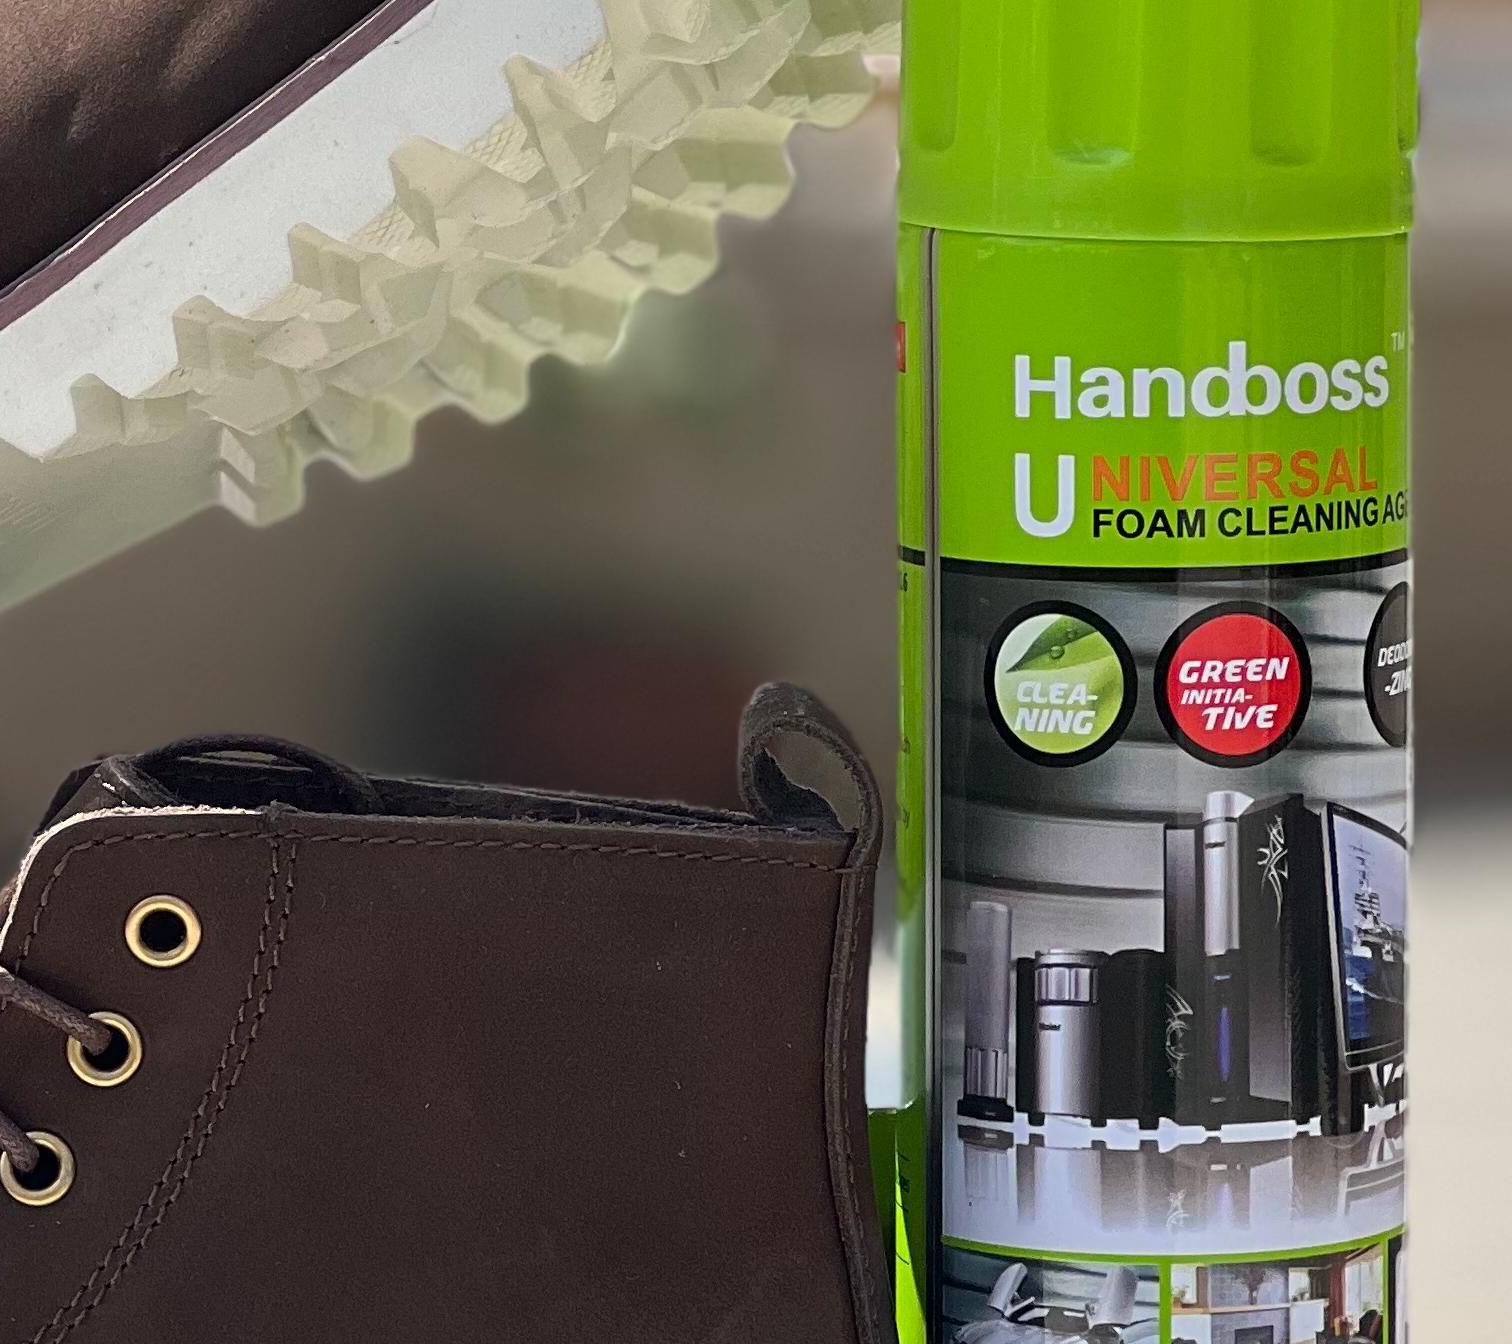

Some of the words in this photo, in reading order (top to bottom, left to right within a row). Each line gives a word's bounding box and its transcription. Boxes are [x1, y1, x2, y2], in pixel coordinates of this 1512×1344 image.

[1014, 340, 1389, 419] Handboss
[1092, 508, 1206, 538] FOAM
[1217, 496, 1379, 536] CLEANING
[1178, 656, 1290, 684] GREEN
[1016, 680, 1099, 706] CLEA-
[1180, 687, 1254, 705] INITIA-
[1014, 707, 1096, 735] NING
[1201, 704, 1278, 731] TIVE
